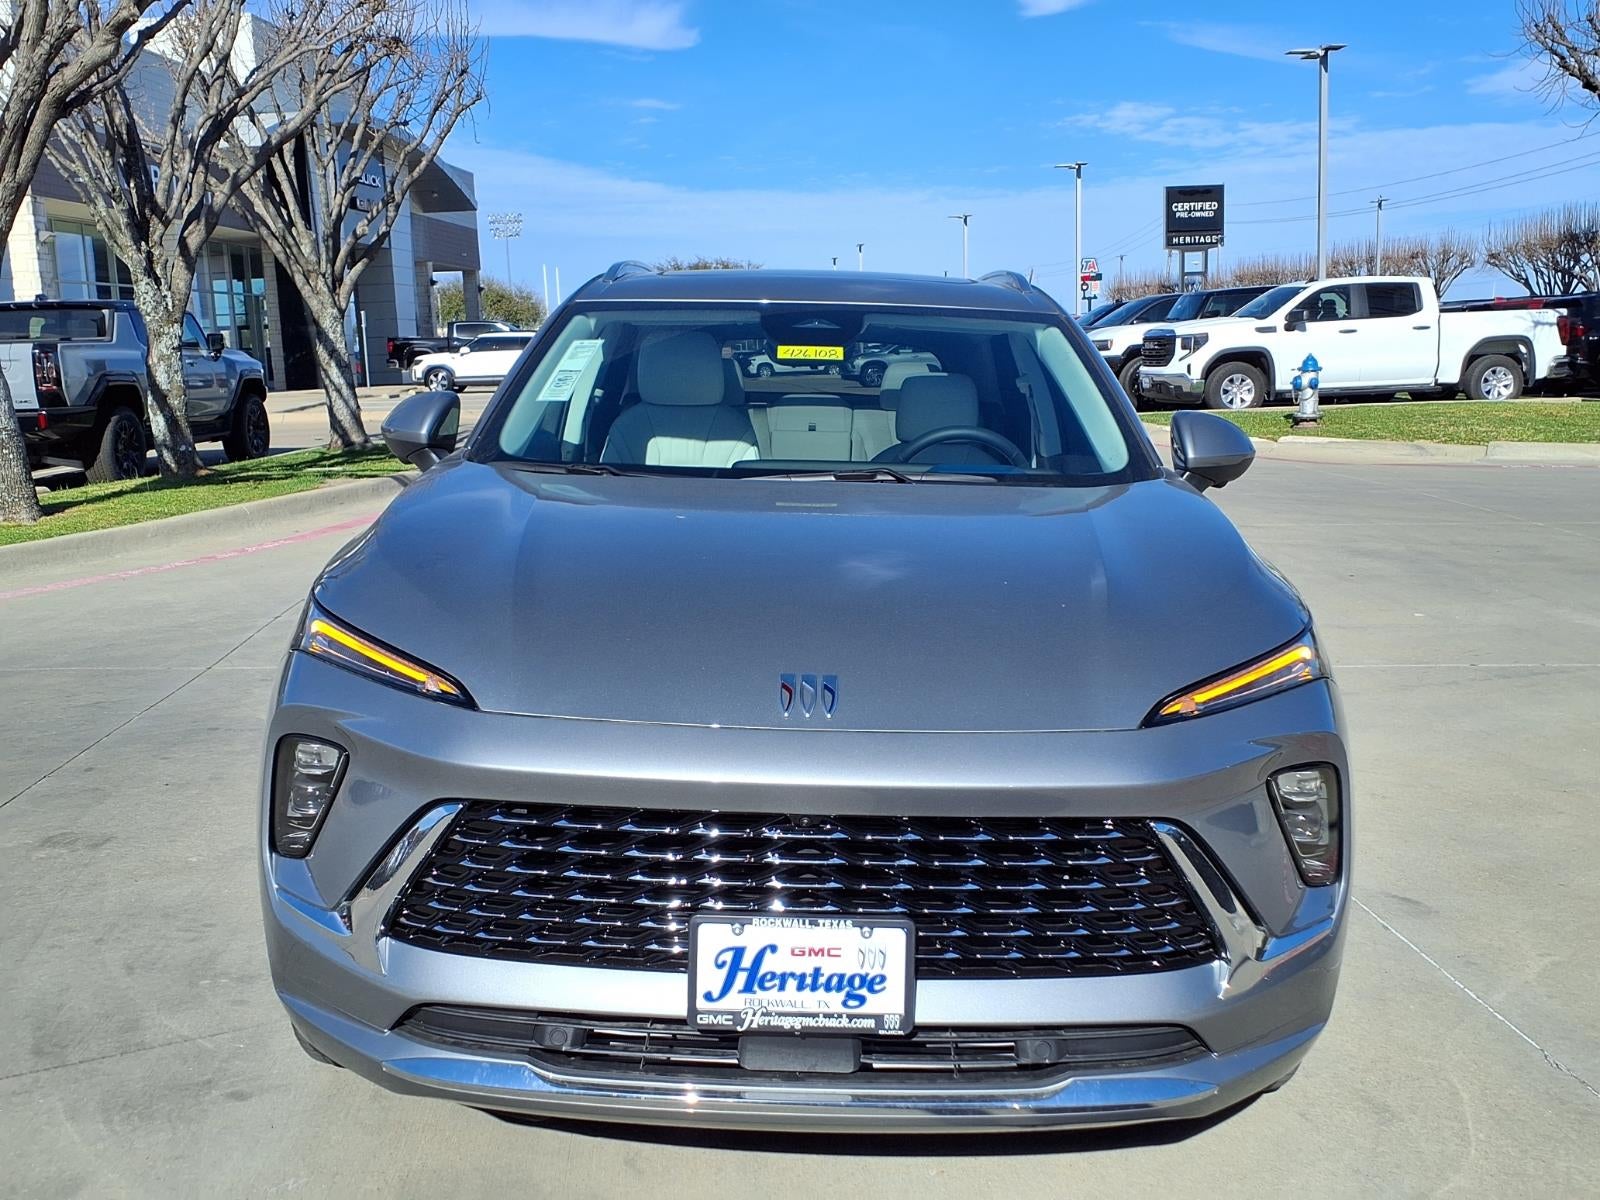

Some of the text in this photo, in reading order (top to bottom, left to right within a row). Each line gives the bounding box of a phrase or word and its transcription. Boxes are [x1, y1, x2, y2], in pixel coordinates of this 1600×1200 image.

[1171, 201, 1218, 211] CERTIFIED
[1172, 235, 1218, 245] HERITAGE
[1083, 259, 1098, 272] TA
[817, 919, 853, 929] TEXAS
[790, 947, 842, 958] GMC
[703, 943, 887, 1009] Heritage
[817, 1000, 831, 1009] TX
[696, 1014, 734, 1025] GMC
[736, 1006, 876, 1032] Heritagegmcbuick.com
